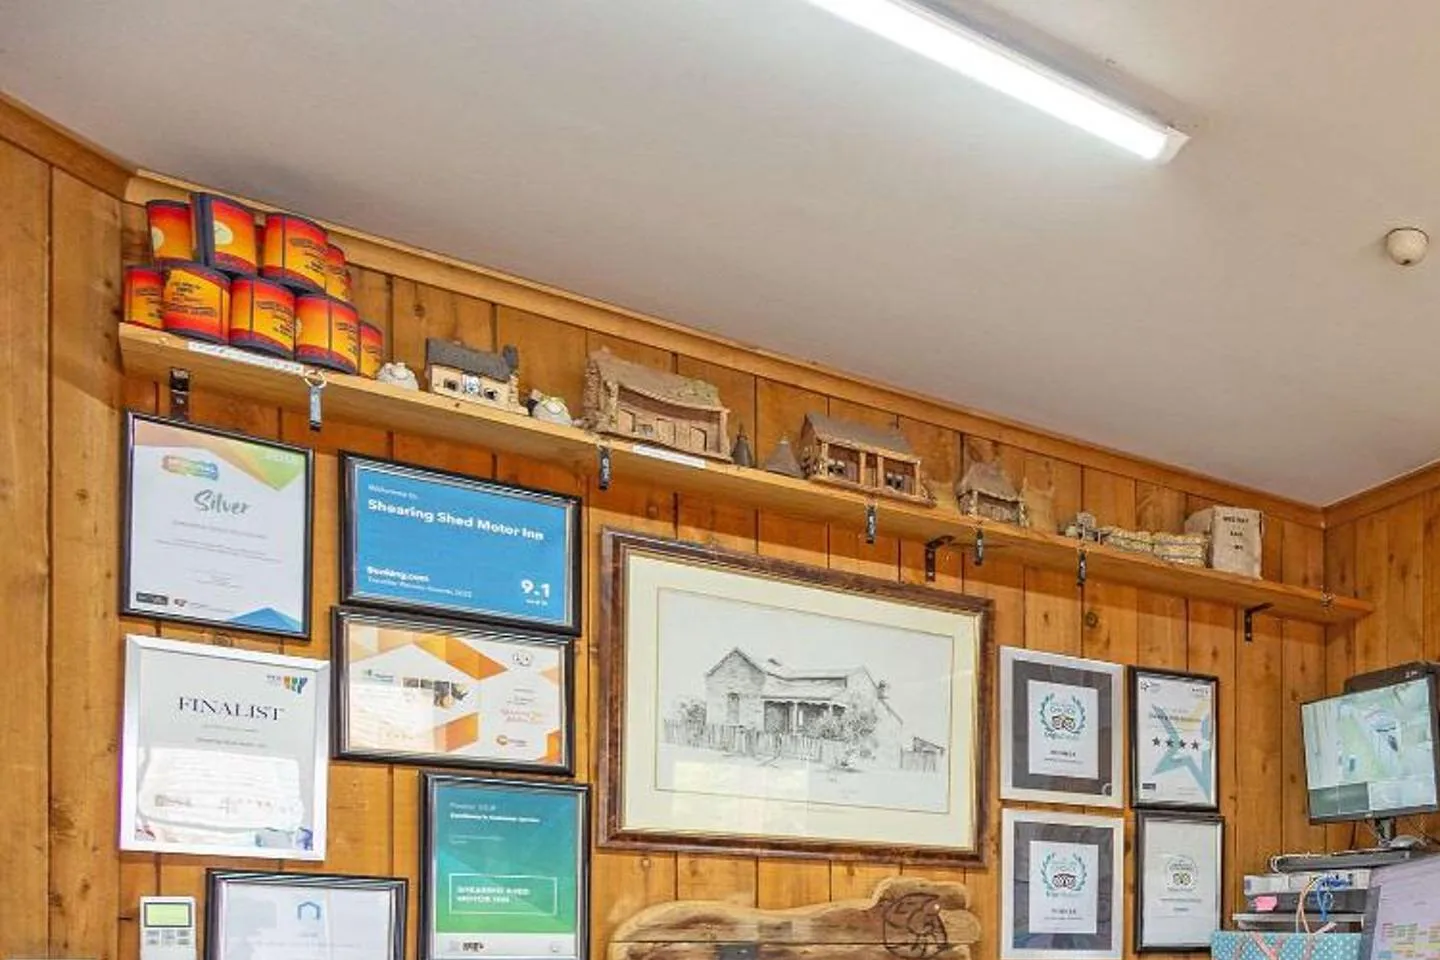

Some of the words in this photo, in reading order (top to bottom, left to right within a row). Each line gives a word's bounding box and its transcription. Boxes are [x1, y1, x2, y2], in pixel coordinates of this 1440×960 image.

[194, 489, 249, 515] Silver
[368, 499, 433, 523] Shearing
[437, 511, 473, 528] Shed
[477, 519, 520, 537] Motor
[522, 528, 544, 540] Inn
[521, 579, 550, 598] 9.1
[178, 696, 284, 721] FINALIST
